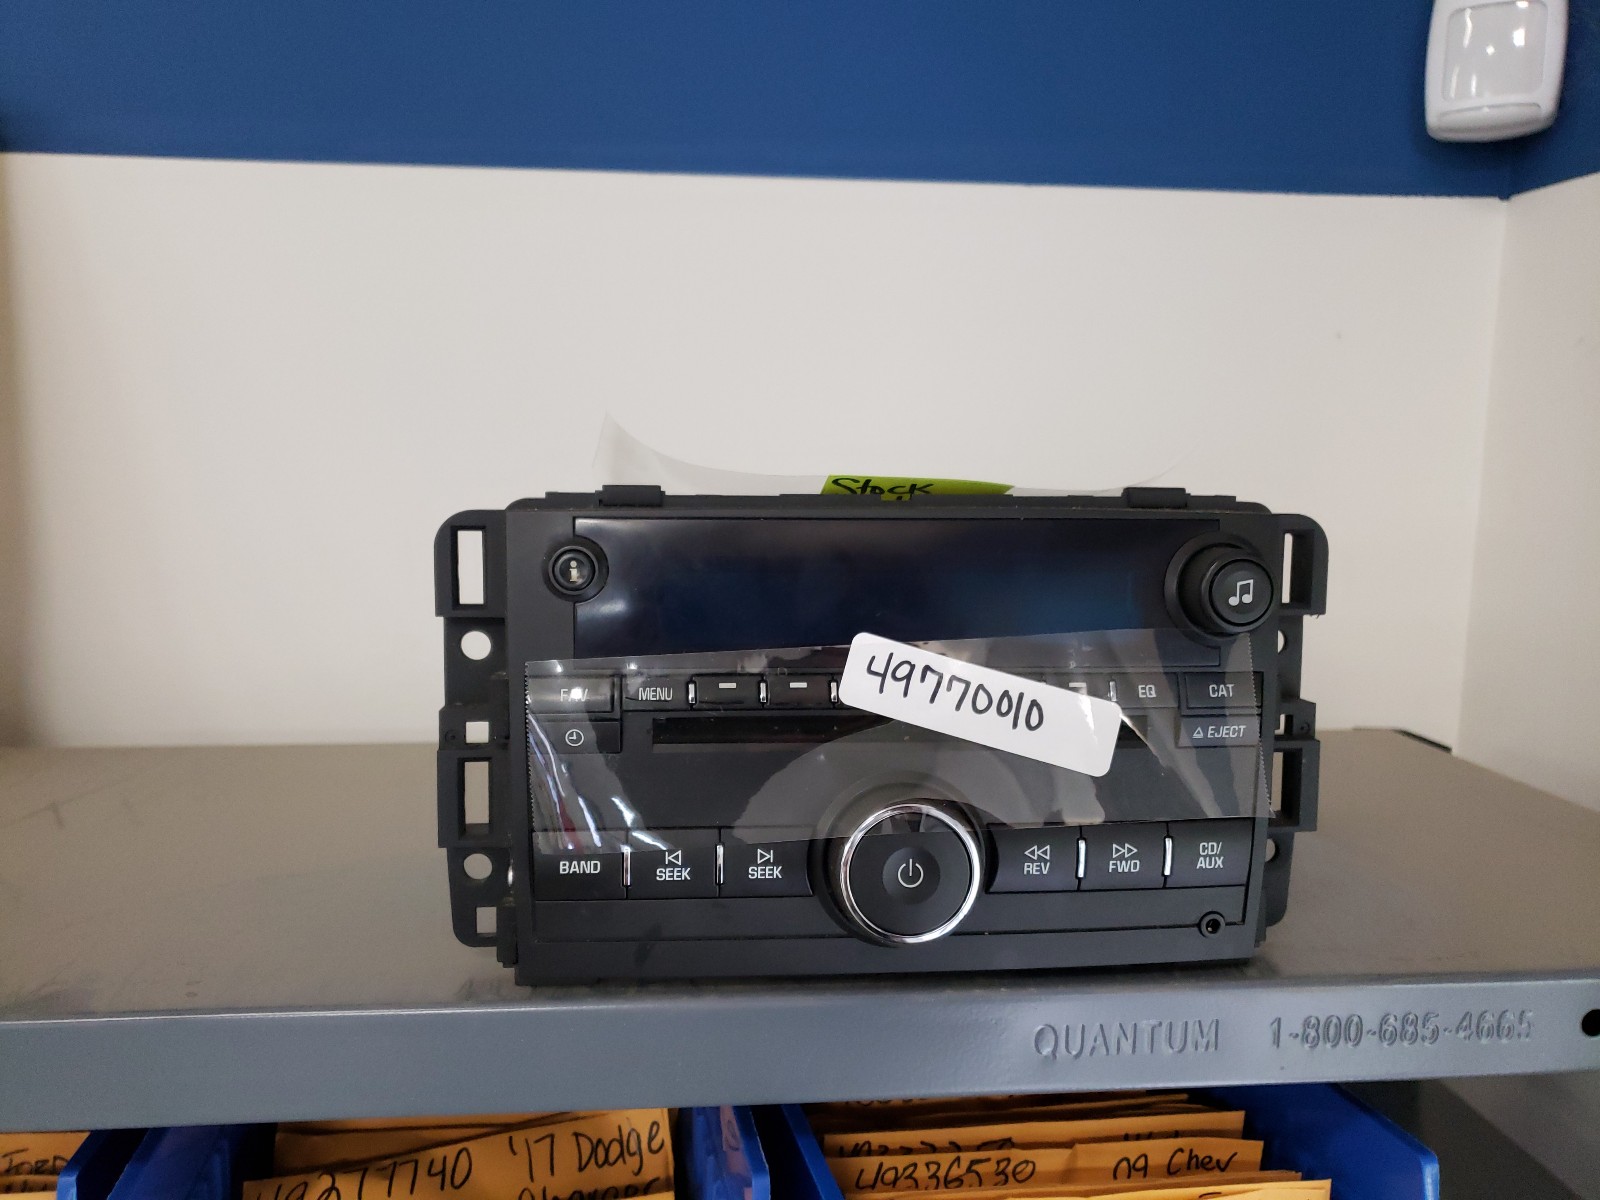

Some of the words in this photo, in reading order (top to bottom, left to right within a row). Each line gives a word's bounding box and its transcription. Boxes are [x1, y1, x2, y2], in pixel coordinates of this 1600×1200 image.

[638, 687, 674, 701] MENU
[866, 652, 1044, 732] 49770010
[1138, 684, 1157, 699] EQ
[1208, 683, 1236, 698] CAT
[1207, 724, 1247, 740] EJECT
[1199, 841, 1223, 857] CD/
[559, 861, 601, 875] BAND
[1023, 861, 1050, 876] REV
[1108, 858, 1140, 873] FWD
[1196, 855, 1224, 870] AUX
[655, 867, 692, 882] SEEK
[747, 866, 783, 880] SEEK
[1033, 1017, 1221, 1062] QUANTUM
[1270, 1009, 1535, 1050] 1-800-685-4665
[572, 1119, 665, 1177] Dodge
[1166, 1147, 1239, 1177] Chev
